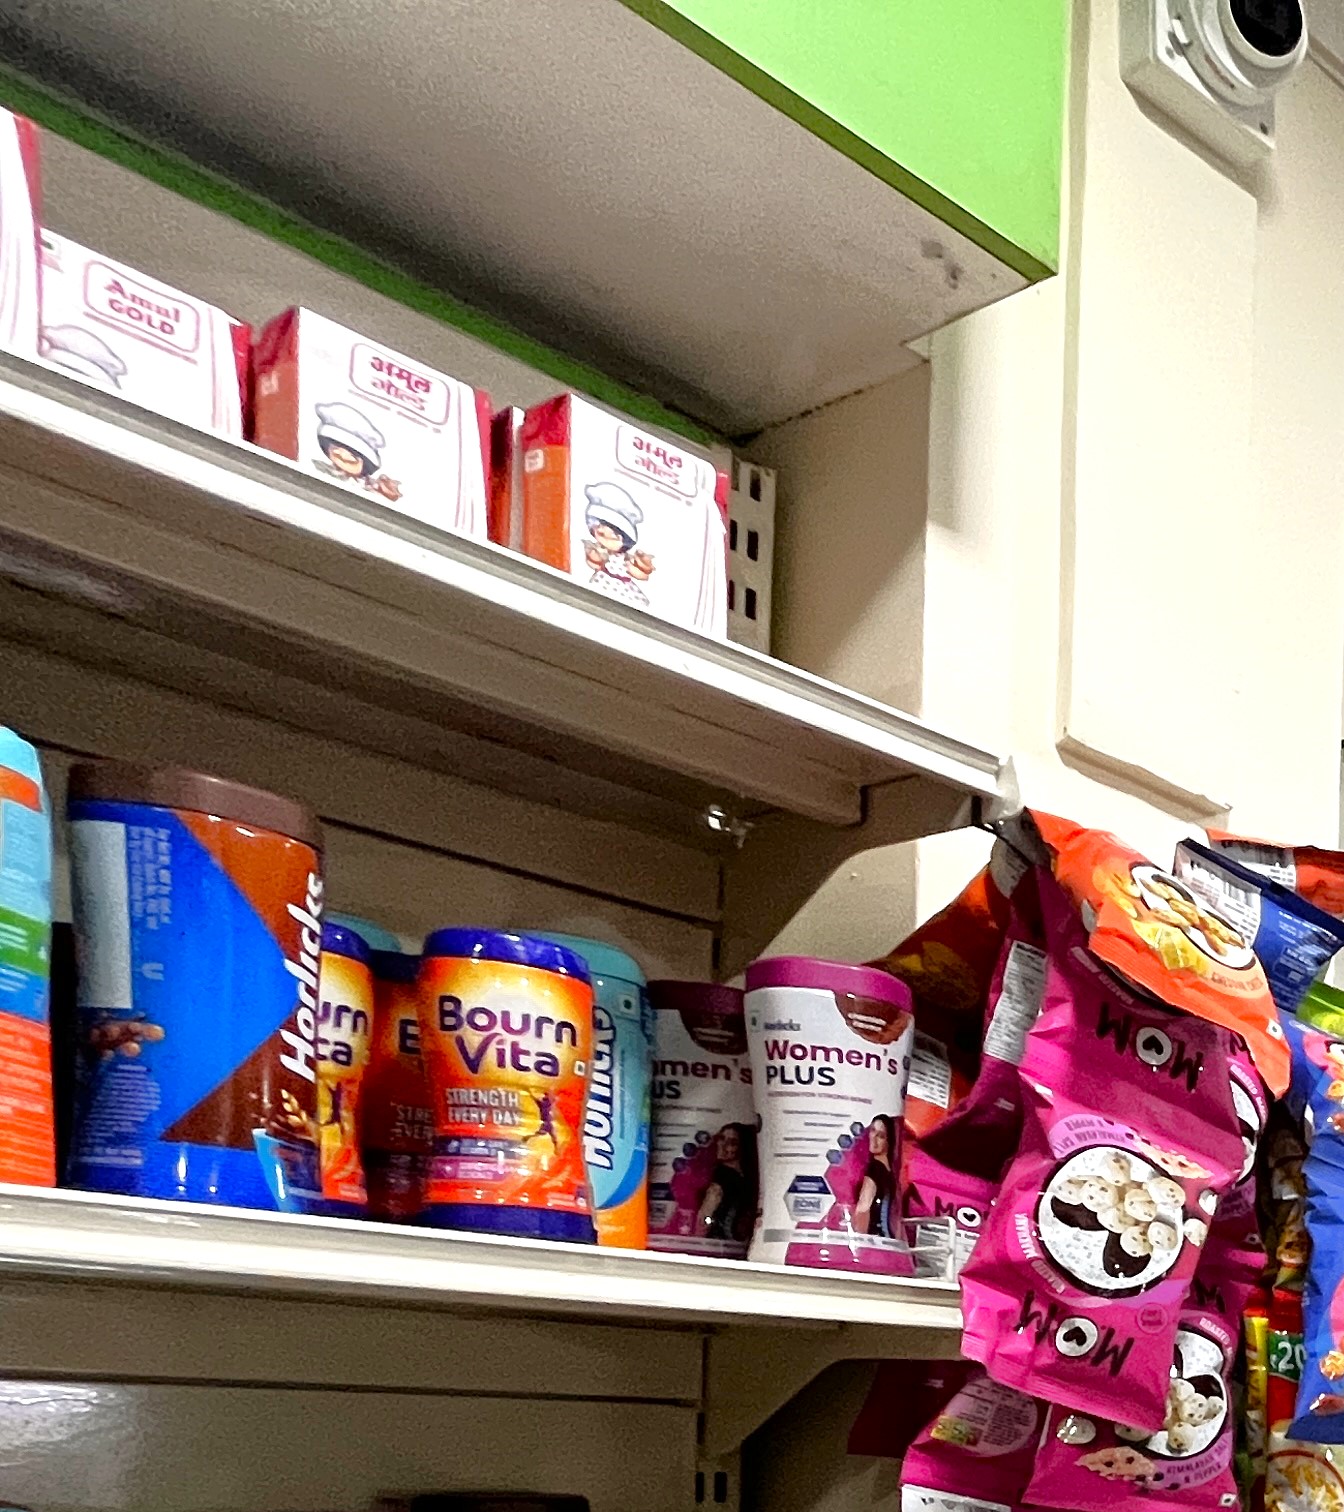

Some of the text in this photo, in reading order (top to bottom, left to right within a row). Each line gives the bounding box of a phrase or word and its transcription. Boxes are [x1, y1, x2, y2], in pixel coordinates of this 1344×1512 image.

[104, 279, 180, 322] Amul
[108, 299, 176, 336] GOLD
[438, 995, 579, 1048] Bourn
[455, 1031, 561, 1077] Vita
[765, 1039, 899, 1076] Women's
[766, 1066, 836, 1087] PLUS
[446, 1087, 520, 1107] STRENGTH
[447, 1105, 522, 1126] EVERY DAY
